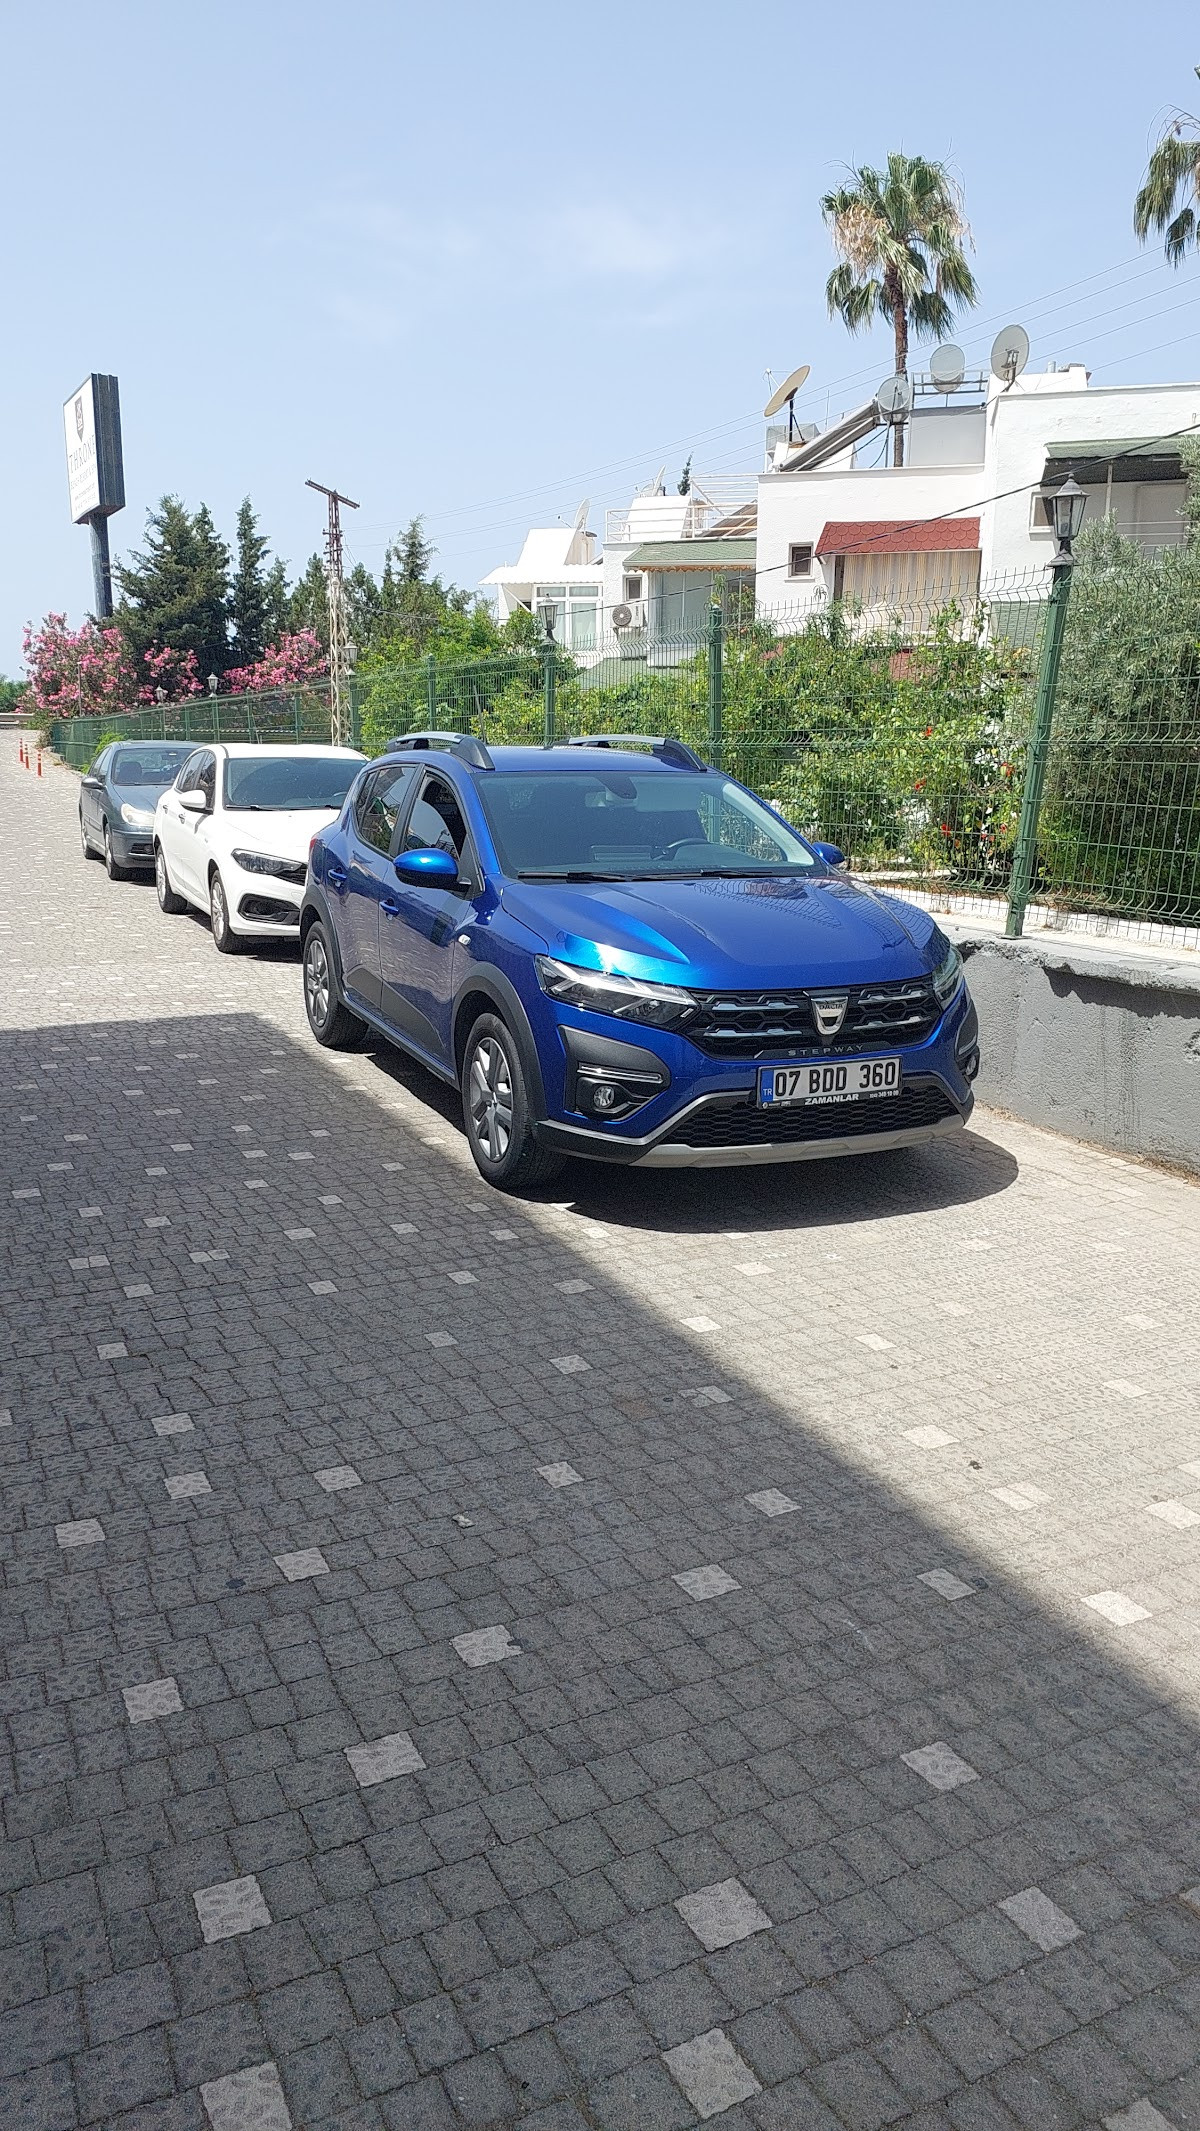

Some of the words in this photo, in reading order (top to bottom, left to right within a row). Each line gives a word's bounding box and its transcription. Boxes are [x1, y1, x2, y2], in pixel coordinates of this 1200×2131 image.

[69, 434, 96, 474] THRONE
[788, 1045, 864, 1056] STEPWAY
[775, 1070, 801, 1097] 07
[809, 1066, 848, 1094] BDD
[859, 1061, 896, 1089] 360
[763, 1088, 773, 1096] TR
[804, 1093, 860, 1106] ZAMANLAR
